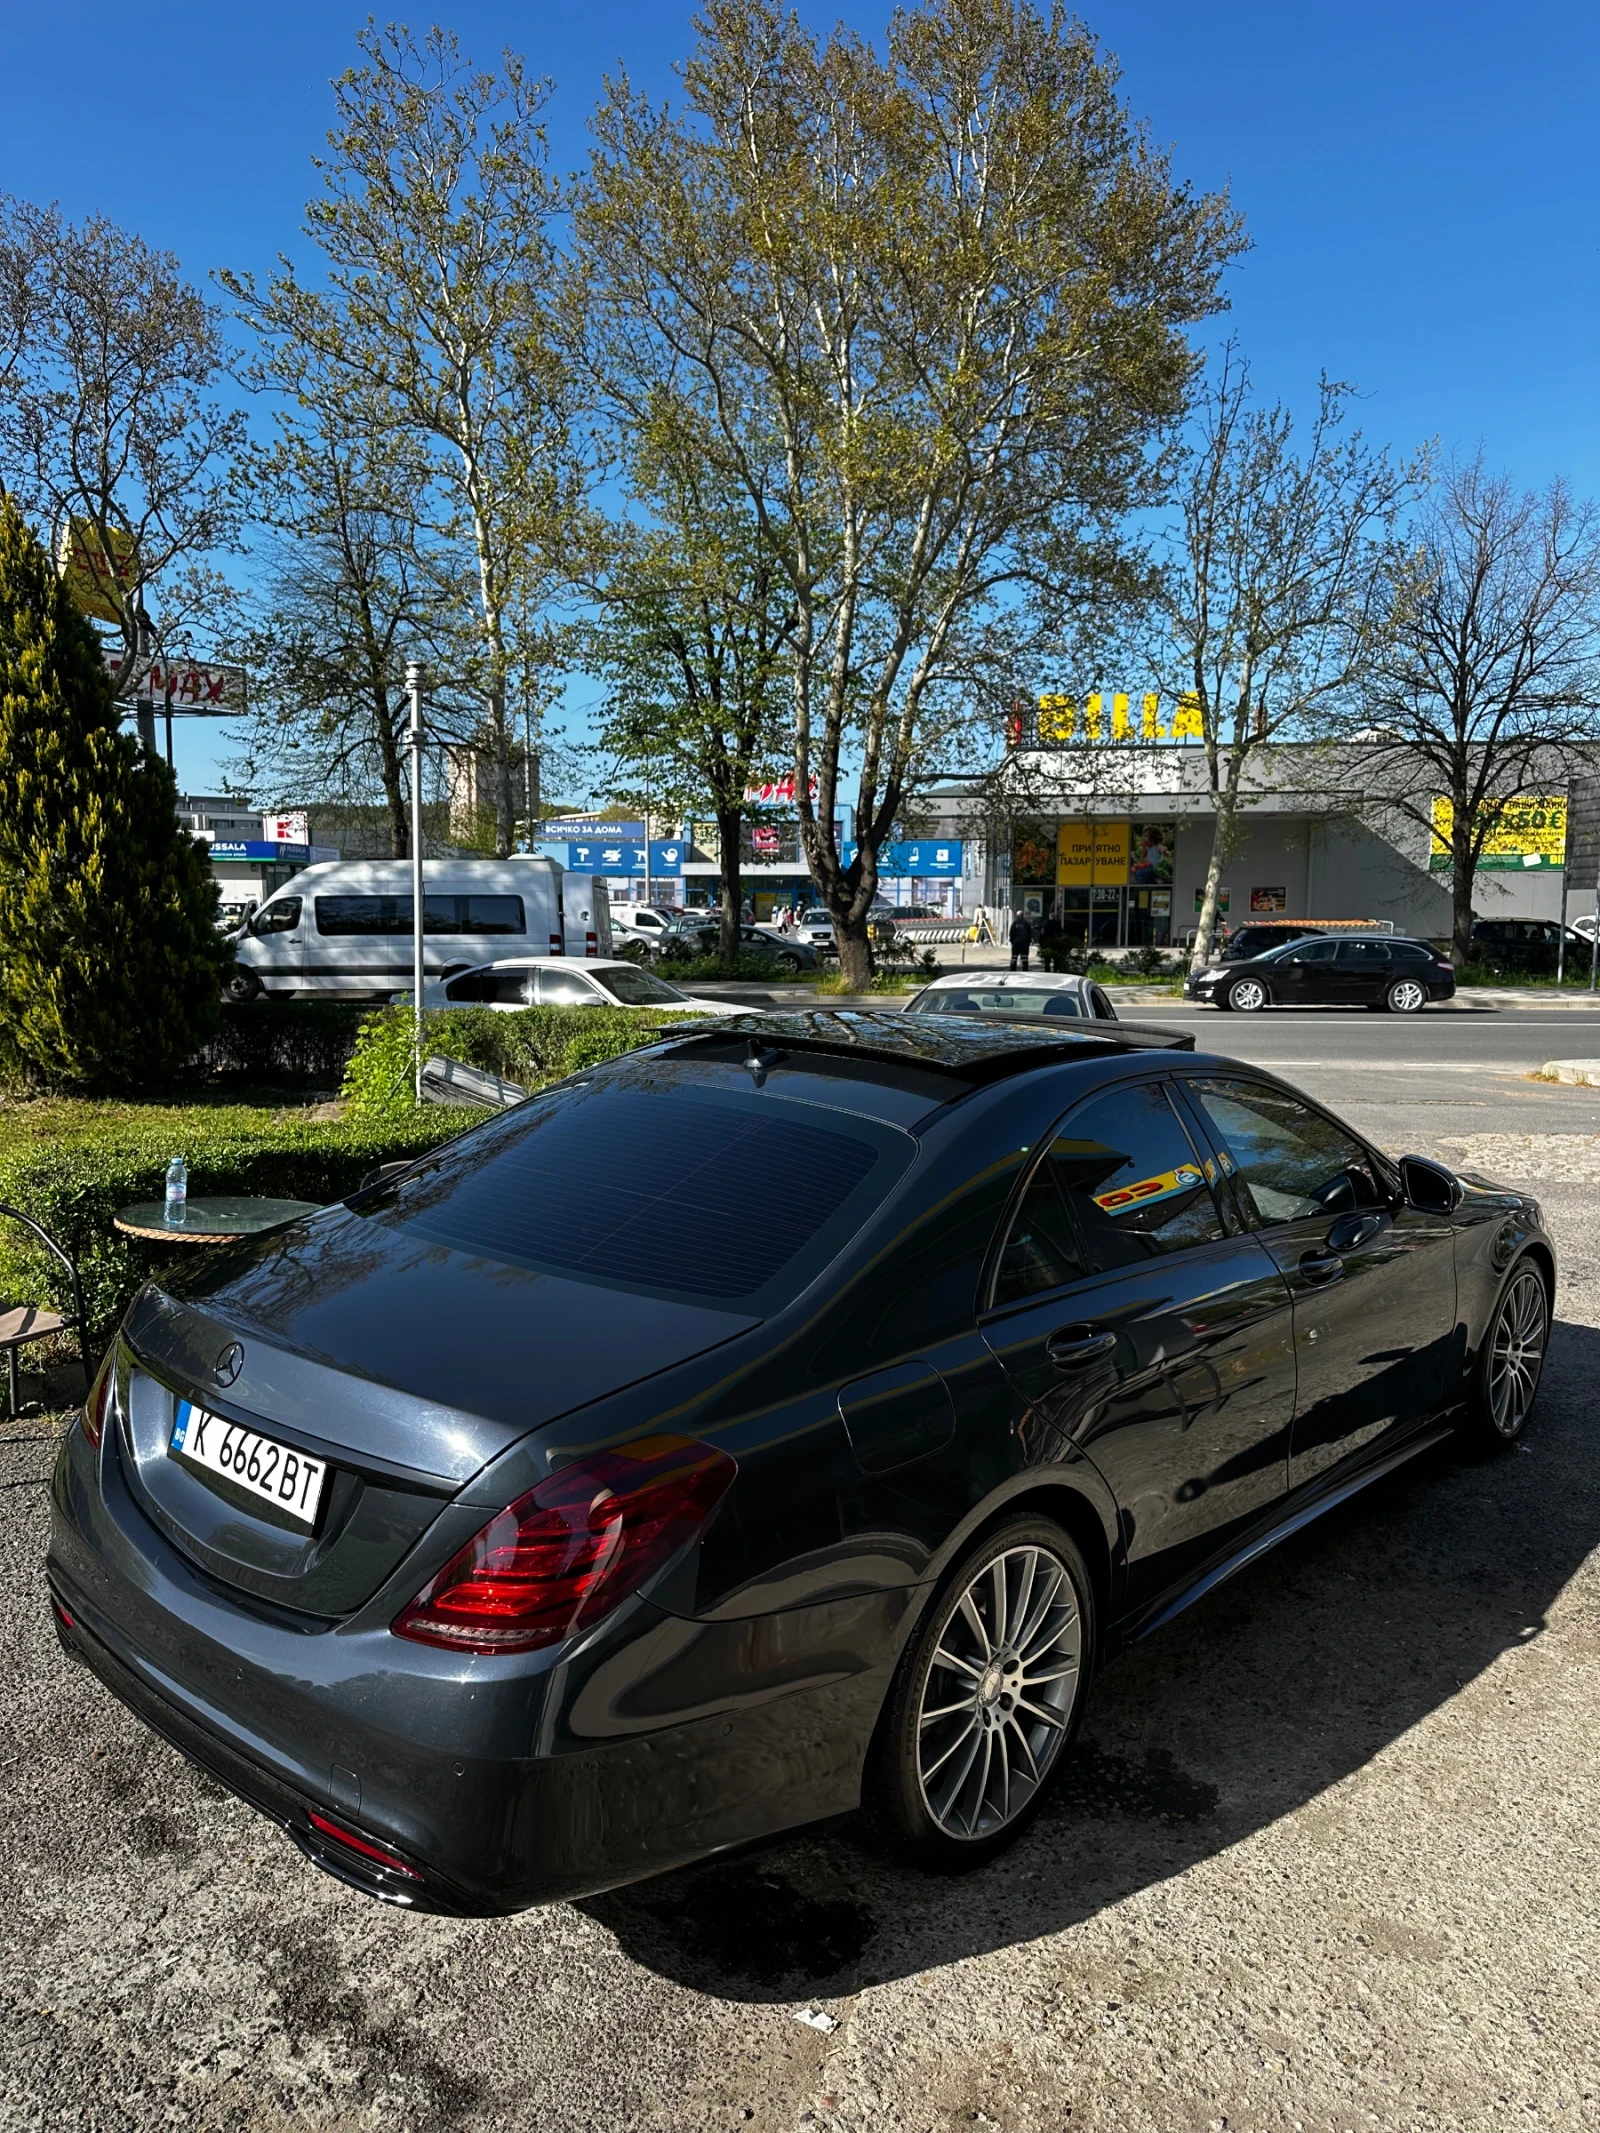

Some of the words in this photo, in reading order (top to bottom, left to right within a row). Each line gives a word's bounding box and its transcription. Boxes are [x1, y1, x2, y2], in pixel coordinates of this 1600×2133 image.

[1039, 691, 1204, 740] BILLA
[546, 825, 581, 834] ВСИЧКО
[582, 825, 593, 834] ЗА
[594, 825, 622, 835] ДОМА
[1072, 844, 1121, 853] ПРИЯТНО
[1060, 857, 1126, 866] ПАЗАРУВАНЕ
[174, 1428, 186, 1443] BG
